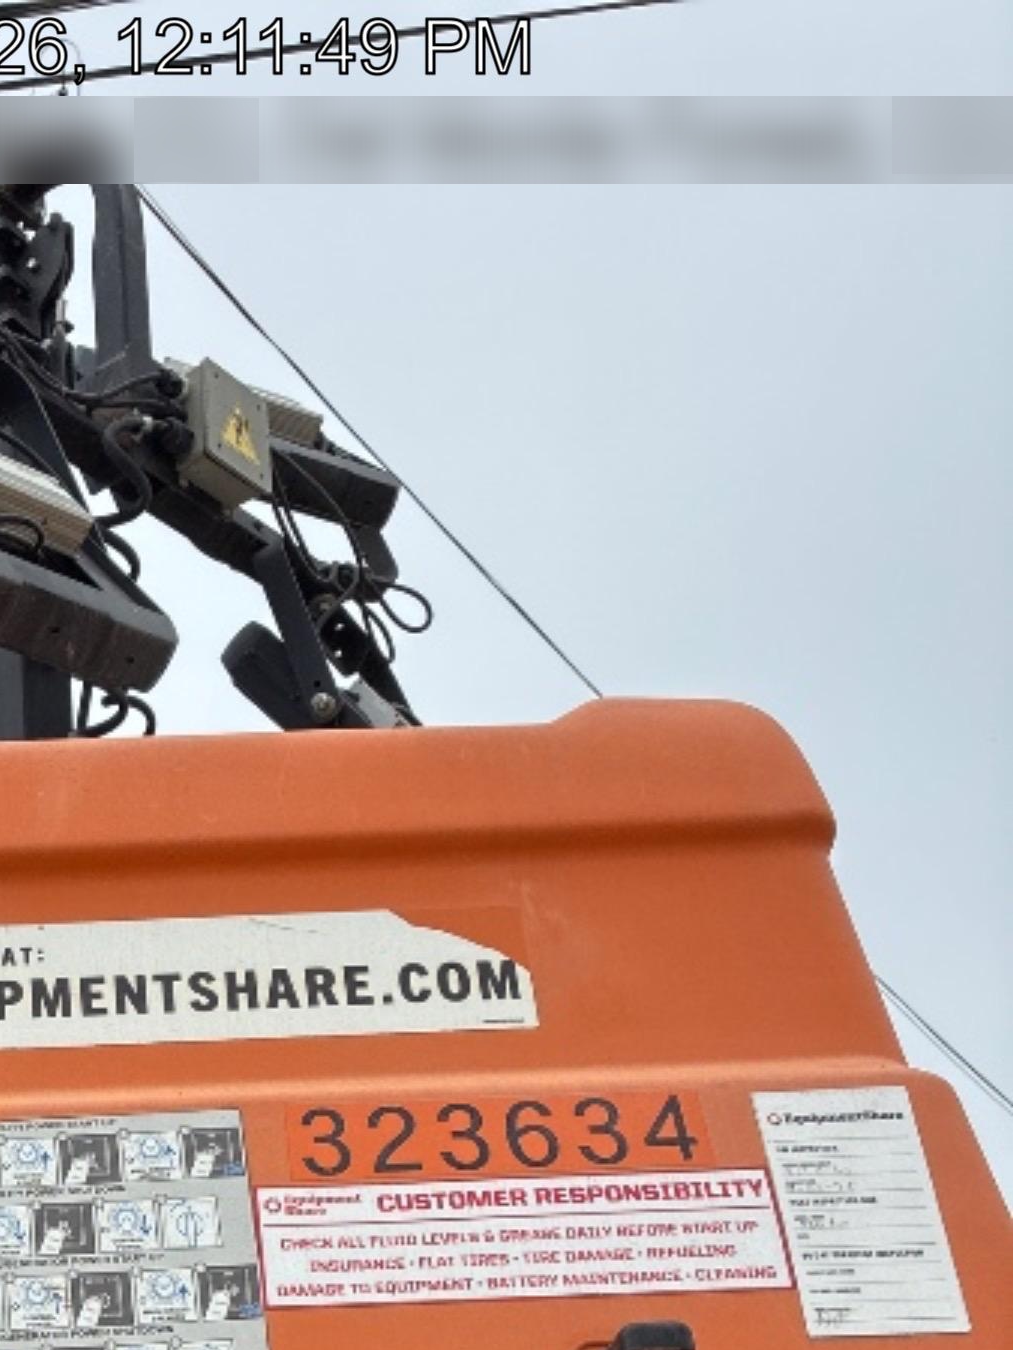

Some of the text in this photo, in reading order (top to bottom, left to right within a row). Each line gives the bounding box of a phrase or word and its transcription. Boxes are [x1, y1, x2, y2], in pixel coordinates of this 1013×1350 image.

[1, 947, 45, 967] AT:
[300, 1094, 698, 1177] 323634
[377, 1188, 528, 1213] CUSTOMER
[535, 1179, 762, 1205] RESPONSIBILITY
[280, 1237, 333, 1251] CHECK
[338, 1235, 366, 1249] ALL
[421, 1231, 480, 1247] LEVELS
[565, 1225, 612, 1240] DAILY
[617, 1222, 678, 1238] BEFORE
[682, 1220, 731, 1235] START
[737, 1219, 760, 1233] UP
[310, 1256, 405, 1273] INSURANCE
[418, 1254, 454, 1269] FLAT
[461, 1252, 510, 1268] TIRES
[565, 1247, 636, 1264] DAMAGE
[646, 1243, 737, 1260] REFUELING
[276, 1264, 778, 1298] DAMAGE TO EQUIPMENT BATTERY MAINTENANCE CLEANING
